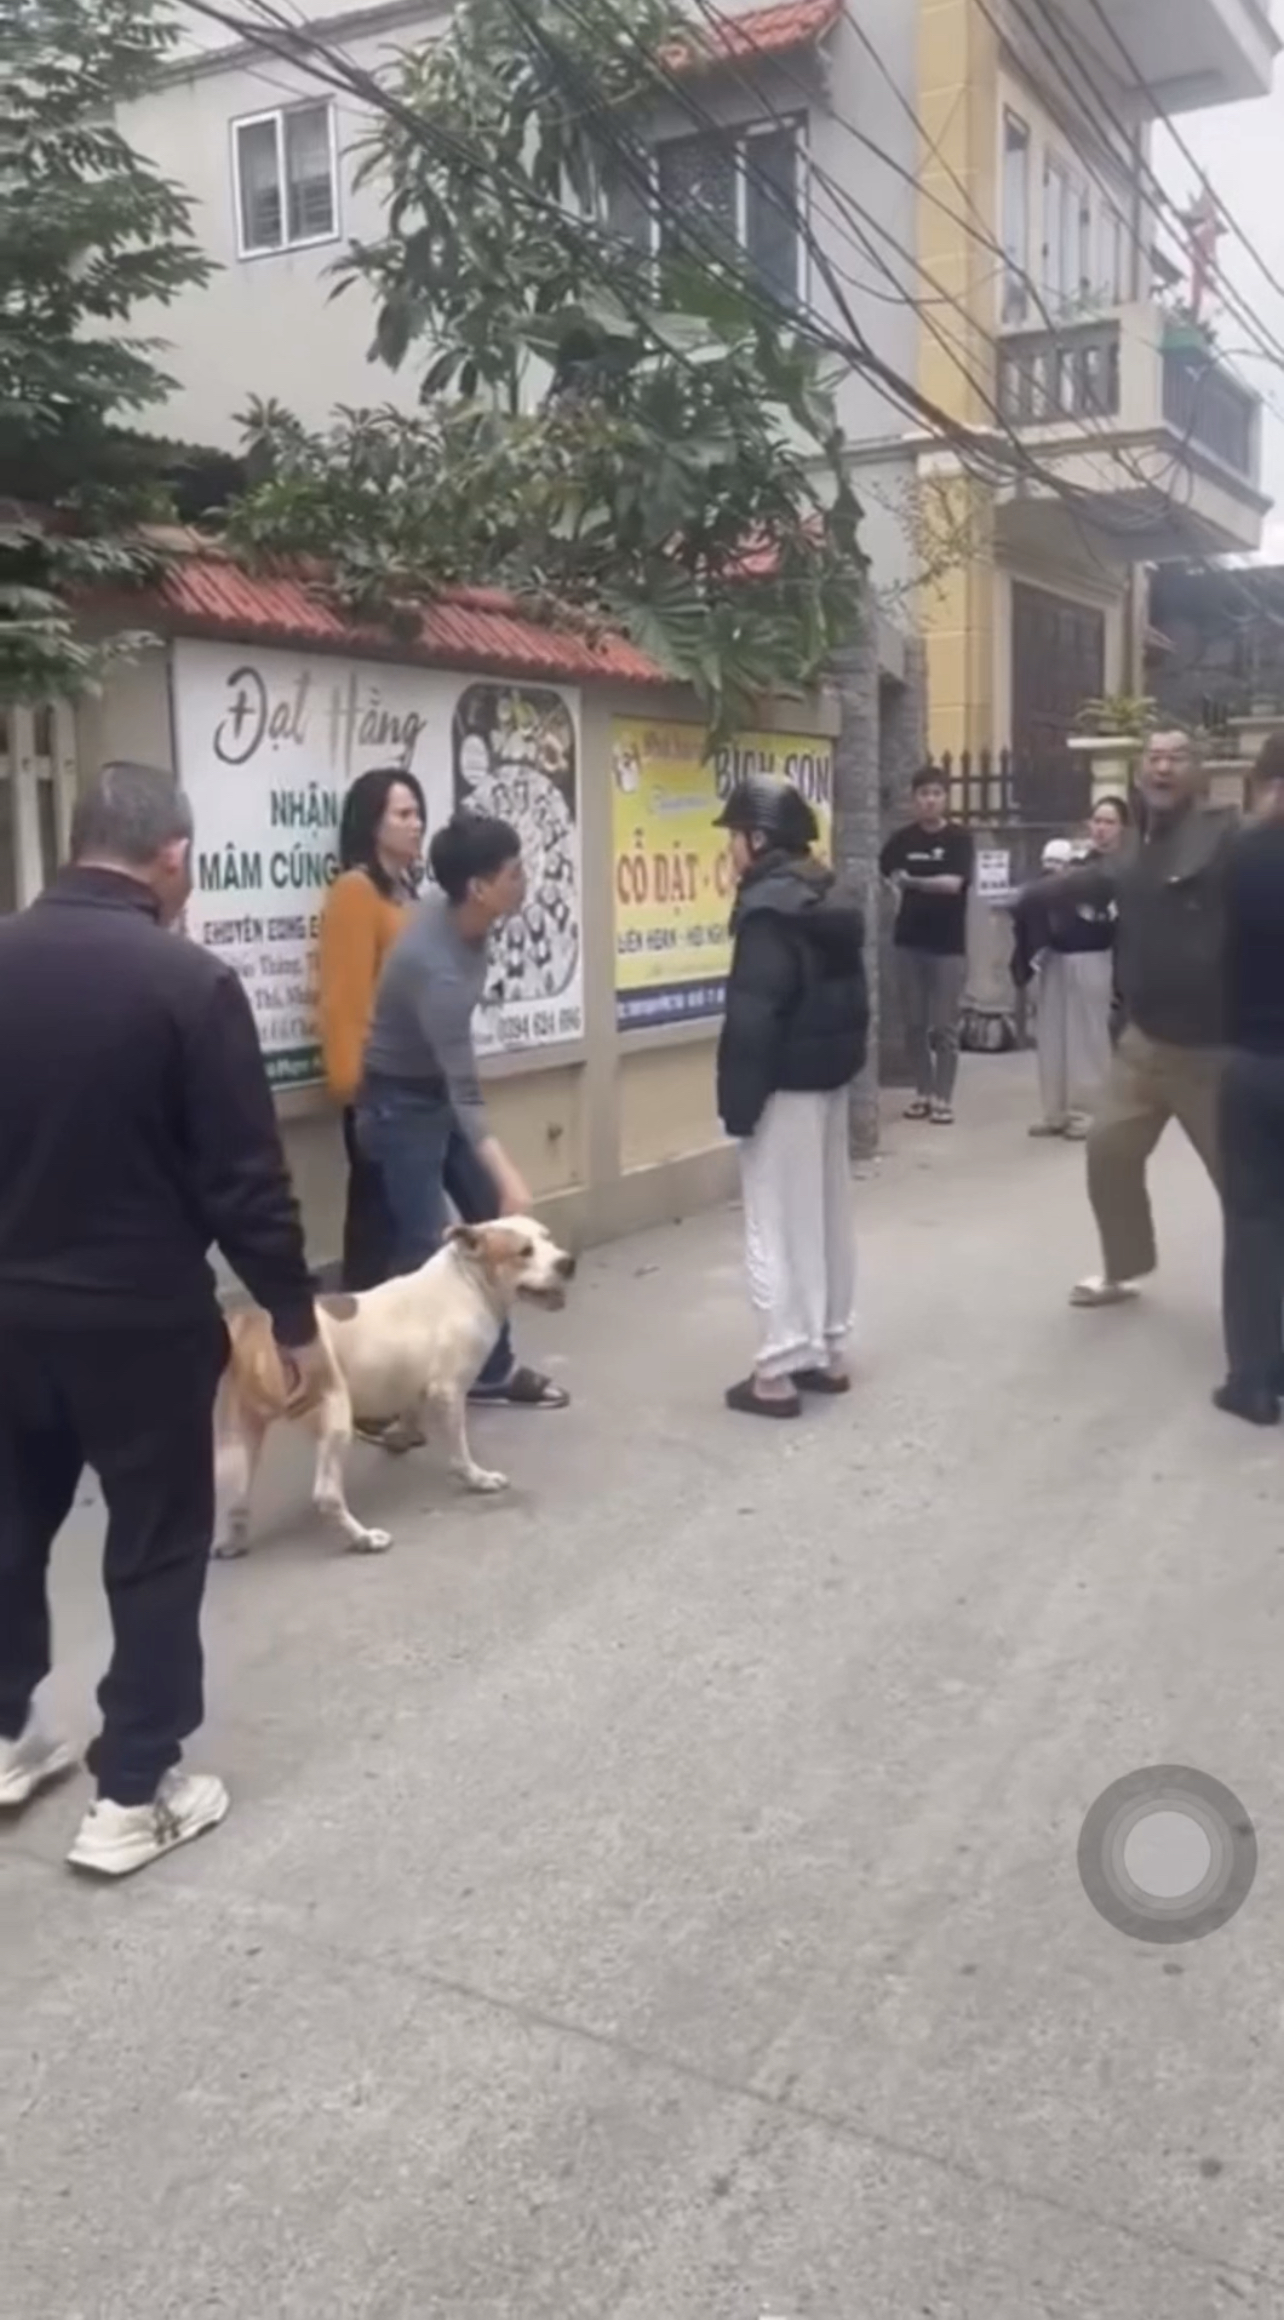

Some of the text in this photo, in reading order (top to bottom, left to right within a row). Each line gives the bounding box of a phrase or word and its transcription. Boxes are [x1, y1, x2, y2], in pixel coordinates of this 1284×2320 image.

[270, 781, 337, 839] NHẬN
[199, 841, 340, 890] MÂM CÚNG
